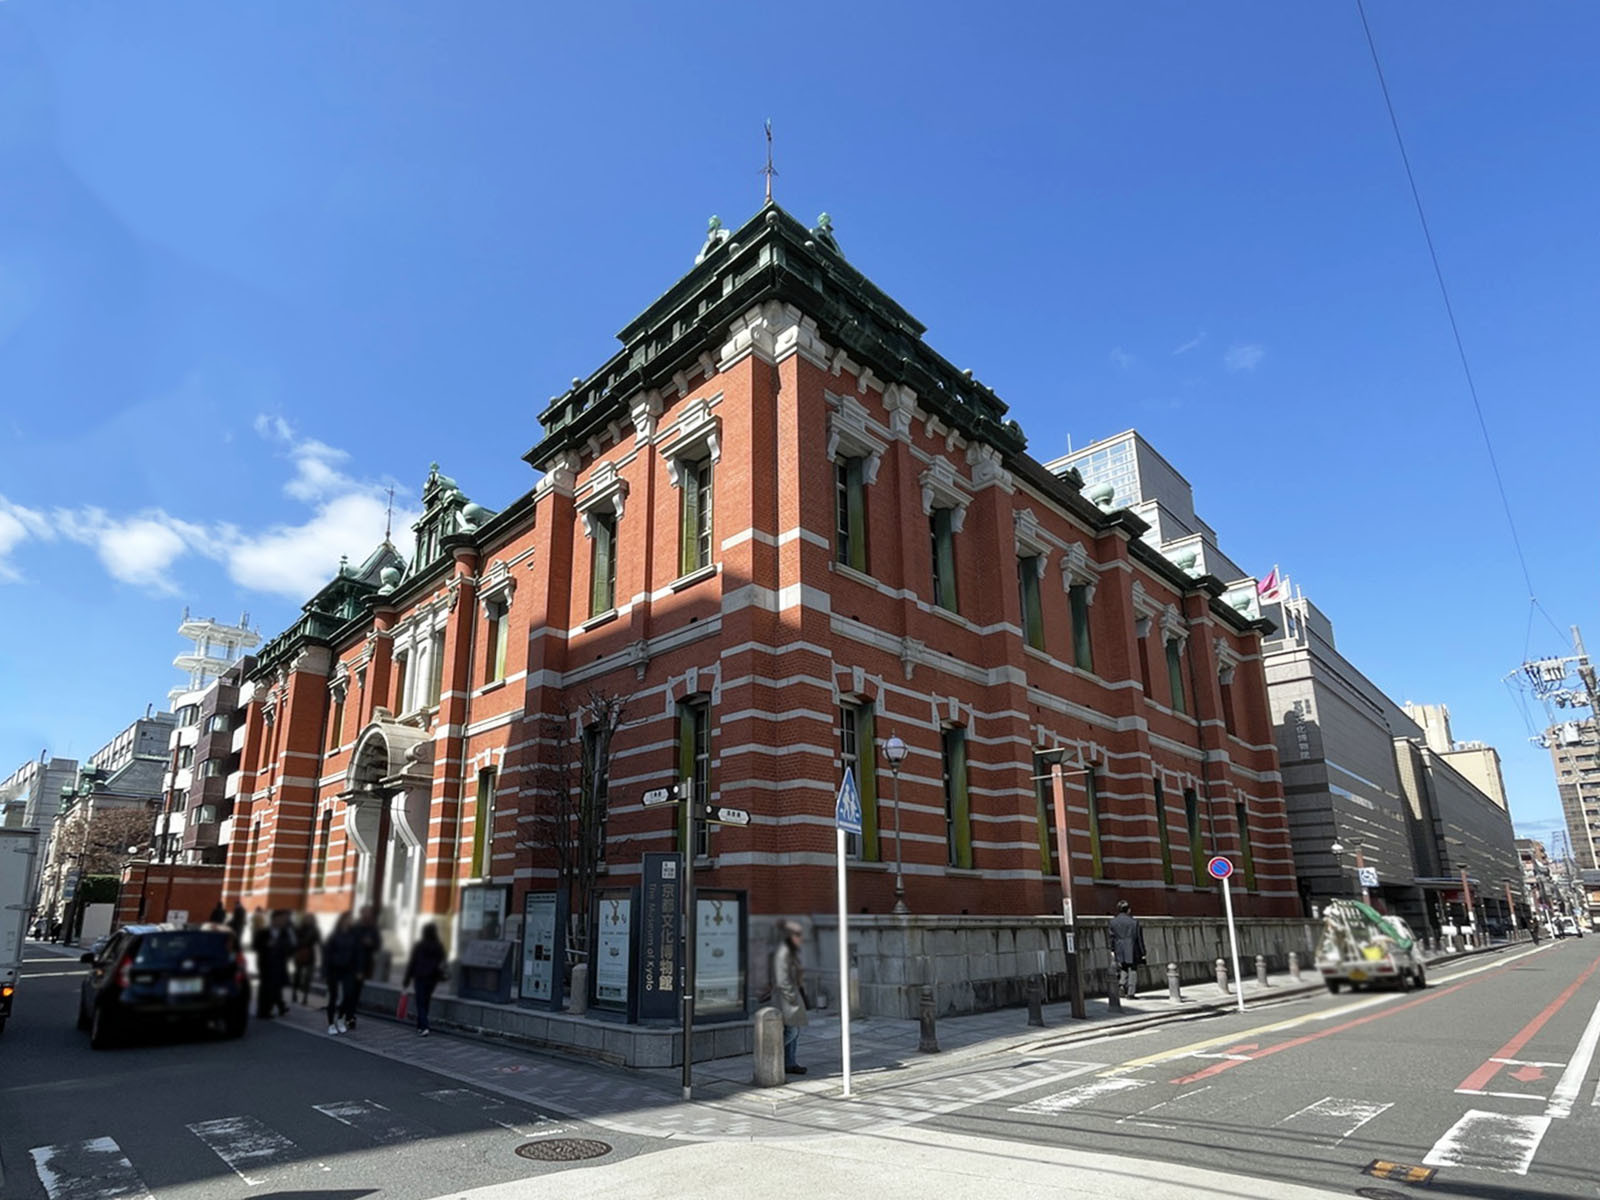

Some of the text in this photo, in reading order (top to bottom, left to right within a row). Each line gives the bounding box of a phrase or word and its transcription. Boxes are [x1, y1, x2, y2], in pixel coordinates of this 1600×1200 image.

[645, 883, 657, 991] The Museum of Kyoto
[659, 883, 675, 991] 京都文化博物館
